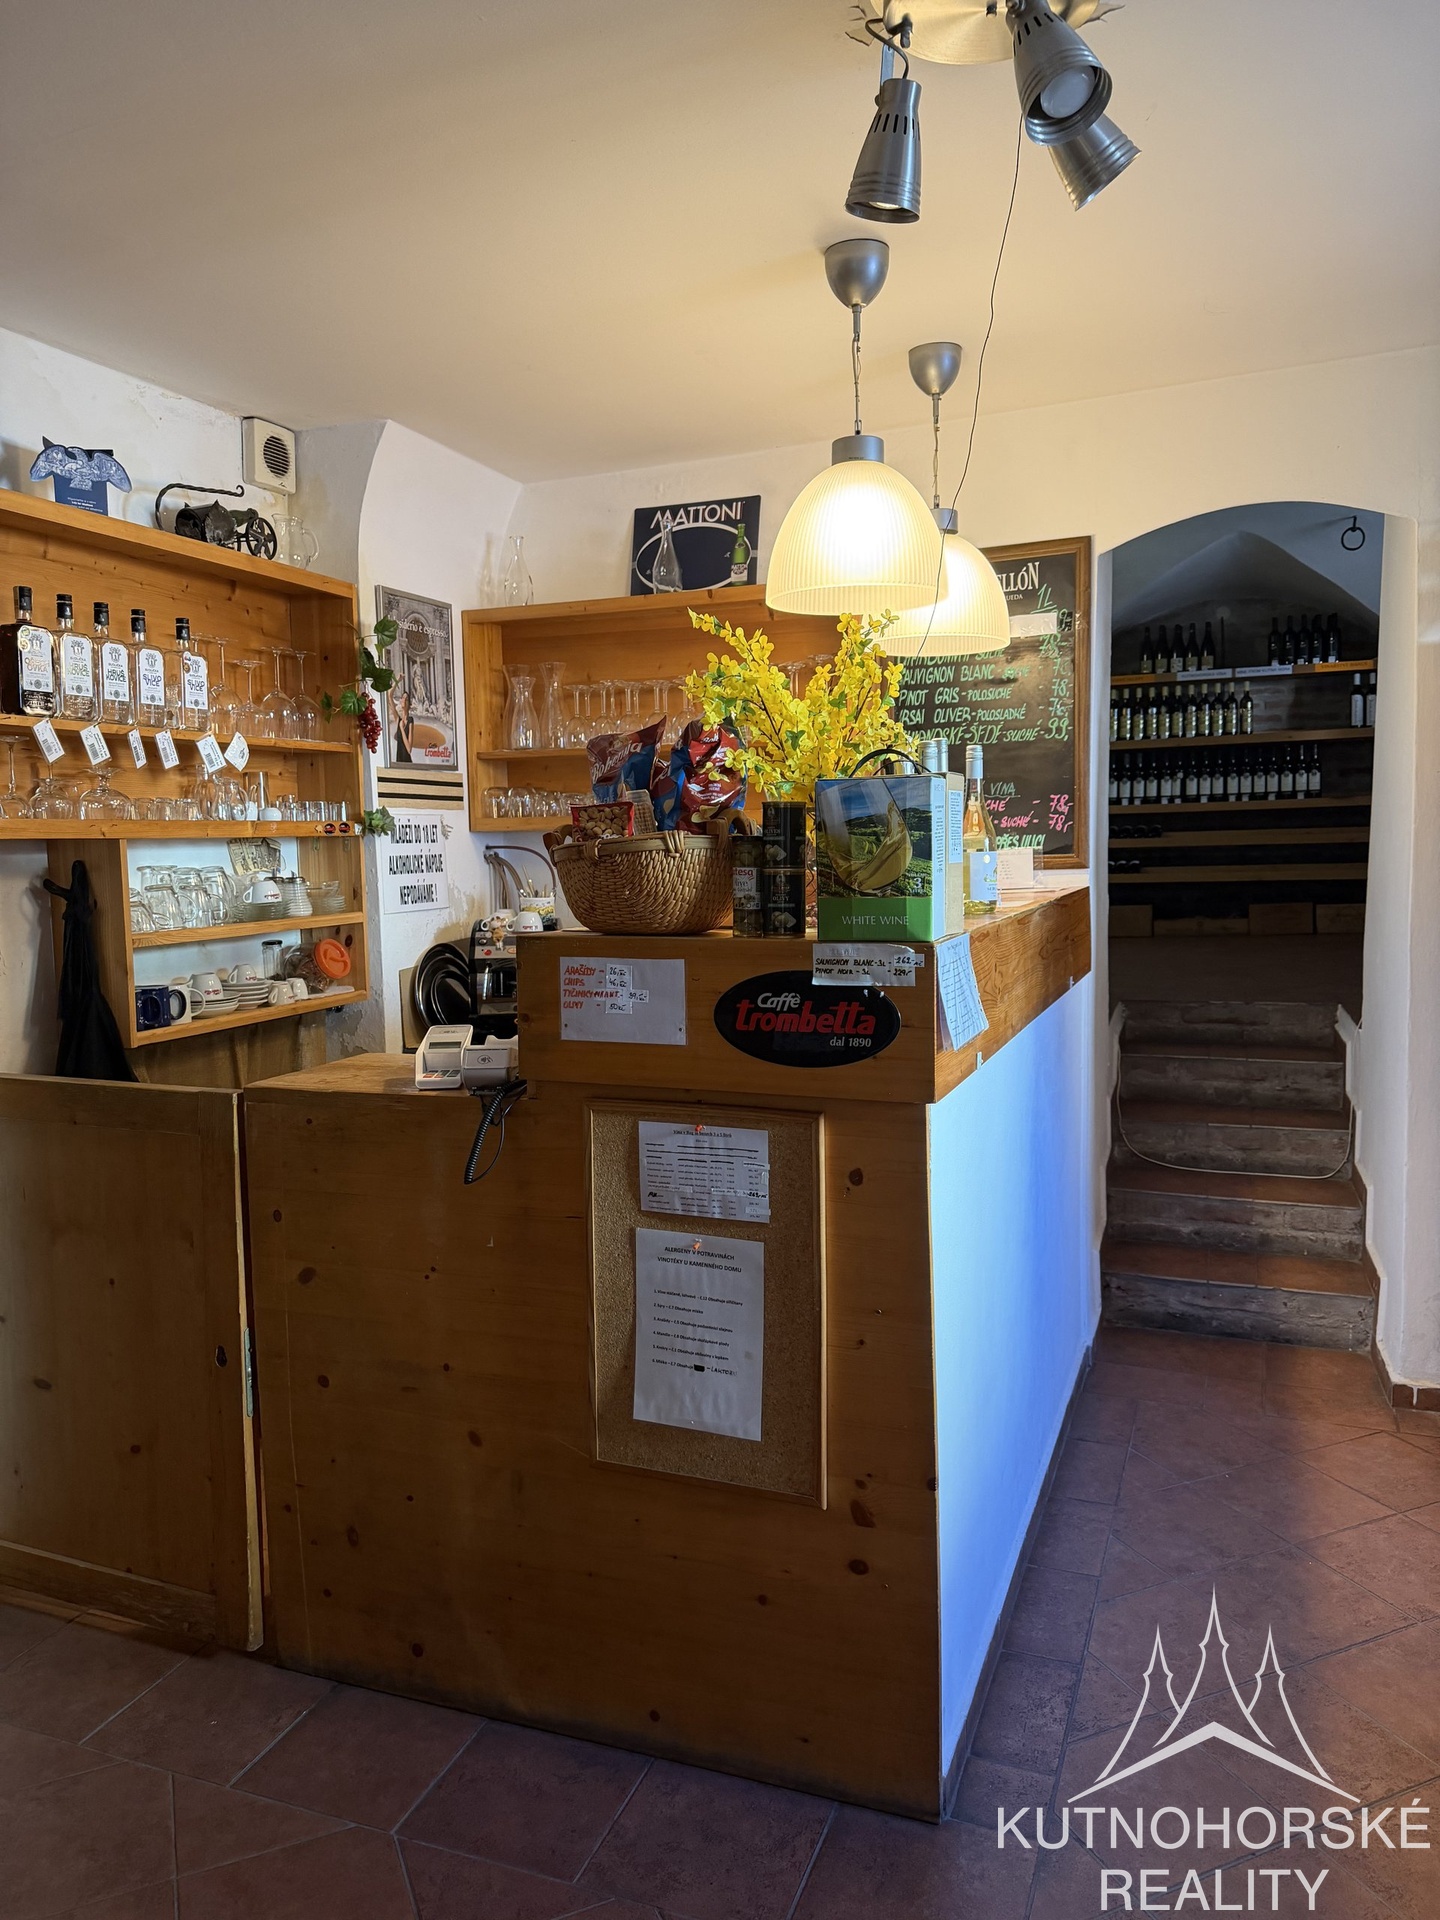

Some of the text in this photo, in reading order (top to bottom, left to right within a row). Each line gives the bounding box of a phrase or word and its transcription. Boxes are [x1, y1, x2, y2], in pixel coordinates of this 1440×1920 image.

[650, 501, 742, 529] MATTONI
[1005, 593, 1024, 602] UEDA
[960, 664, 995, 682] BLANC
[899, 689, 929, 707] PINOT
[934, 687, 960, 705] GRIS
[592, 741, 643, 785] Bohemia
[990, 781, 1016, 795] VÍNA
[414, 824, 421, 844] DO
[429, 824, 438, 844] LET
[388, 849, 444, 876] ALKOHOLICKÉ NÁPOJE
[913, 877, 922, 889] 3
[400, 879, 434, 906] NEPODÁVÁME
[841, 915, 909, 926] WHITE WINE
[815, 957, 850, 967] SAUVIGNON
[563, 964, 597, 976] ARAŠÍDY
[815, 967, 835, 975] PINOT
[563, 977, 586, 987] CHIPS
[757, 992, 801, 1011] Caffè
[736, 1000, 876, 1035] trombetta
[829, 1036, 872, 1047] dal 1890
[664, 1246, 692, 1255] ALERGENY
[697, 1250, 735, 1260] POTRAVINÁCH
[689, 1260, 723, 1271] KAMENNÉHO
[724, 1265, 742, 1273] DOMU
